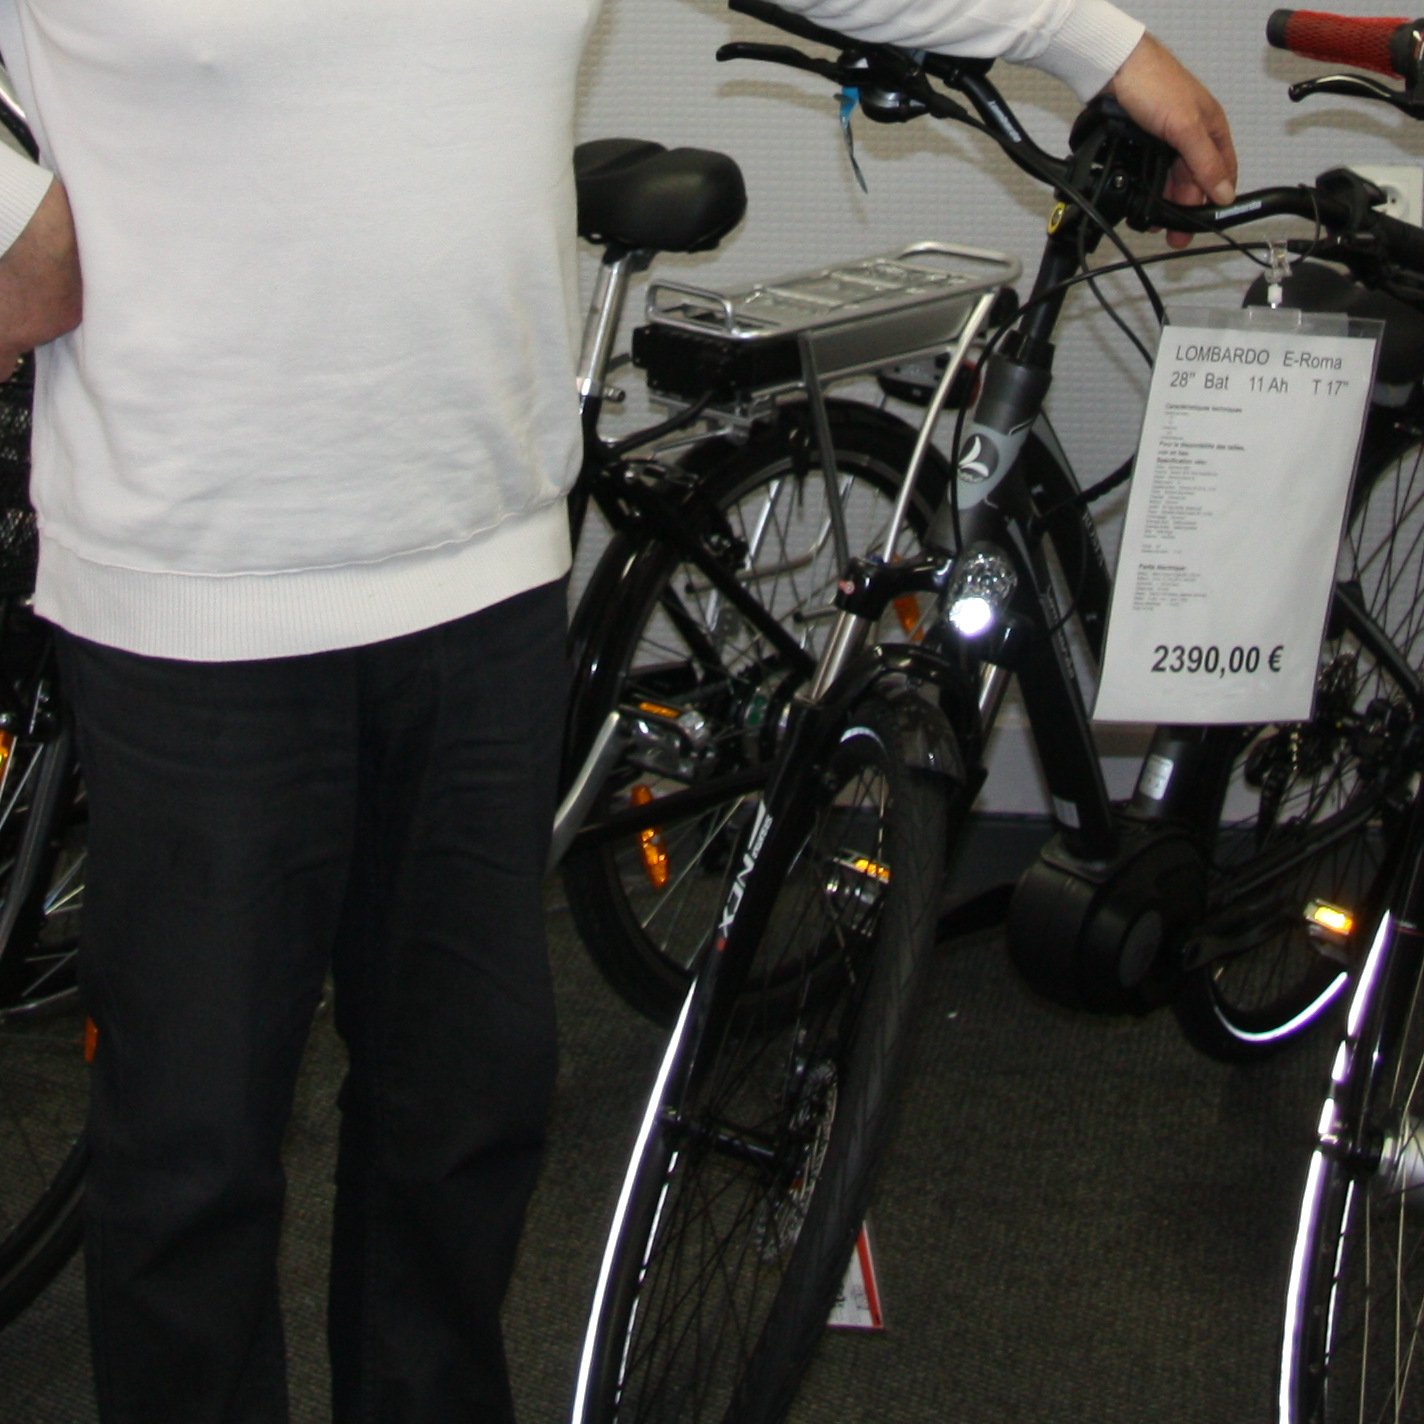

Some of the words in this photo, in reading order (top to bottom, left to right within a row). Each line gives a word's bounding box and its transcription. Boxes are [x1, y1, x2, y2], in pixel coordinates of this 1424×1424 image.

[1175, 344, 1270, 366] LOMBARDO
[1283, 349, 1343, 370] E-Roma
[1204, 373, 1229, 391] Bat
[1249, 375, 1263, 393] 11
[1267, 376, 1289, 394] Ah
[1312, 379, 1323, 396] T
[1151, 644, 1260, 679] 2390,00
[1268, 645, 1284, 673] €
